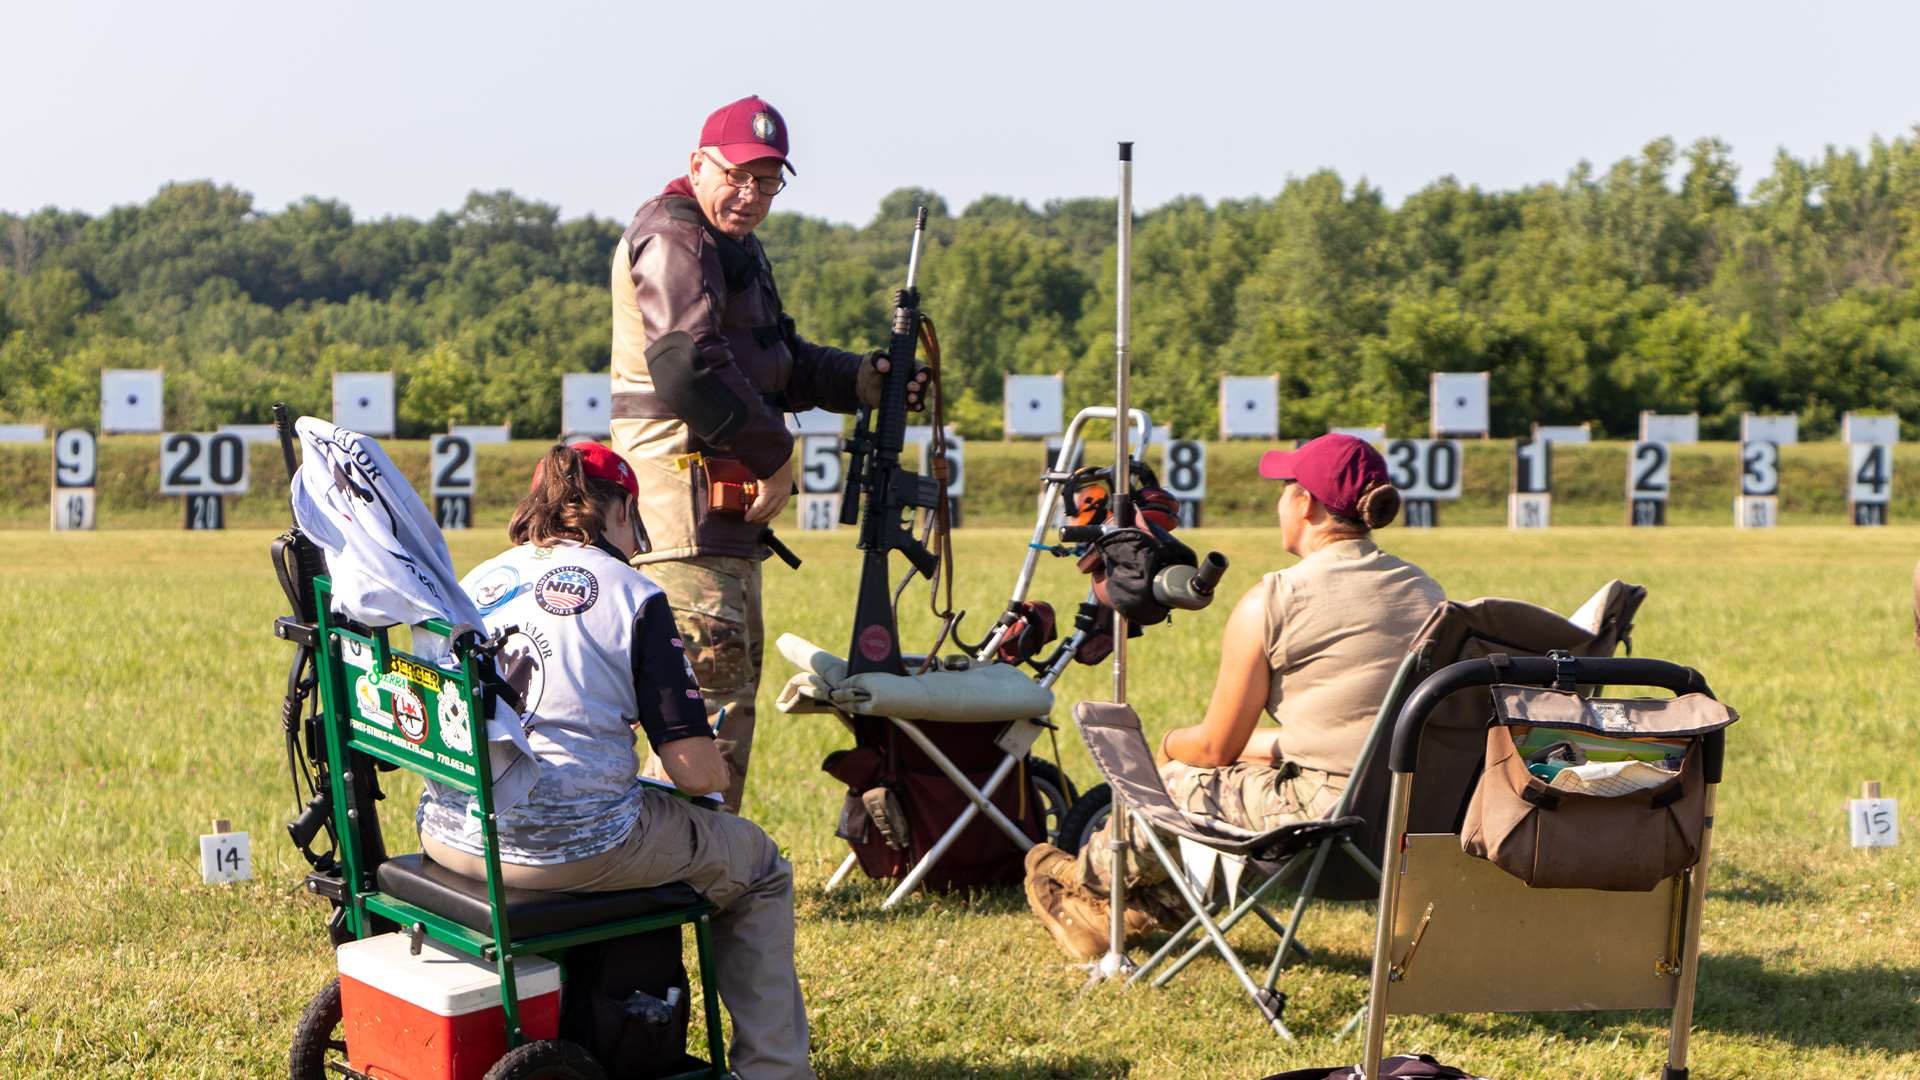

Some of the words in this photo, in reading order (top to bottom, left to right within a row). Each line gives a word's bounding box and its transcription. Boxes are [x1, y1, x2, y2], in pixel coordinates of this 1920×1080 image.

[56, 428, 97, 487] 9
[166, 433, 244, 486] 20
[436, 435, 471, 488] 2
[804, 435, 841, 492] 5
[1168, 441, 1201, 492] 8
[1388, 439, 1458, 491] 30
[1518, 438, 1548, 492] 1
[1634, 441, 1668, 492] 2
[1743, 441, 1779, 494] 3
[1856, 444, 1888, 494] 4
[192, 496, 219, 530] 20
[440, 497, 467, 529] 22
[546, 580, 586, 599] NRA
[525, 621, 553, 659] VALOR
[391, 655, 441, 690] BERGER
[1864, 810, 1891, 835] 15
[216, 846, 245, 872] 14
